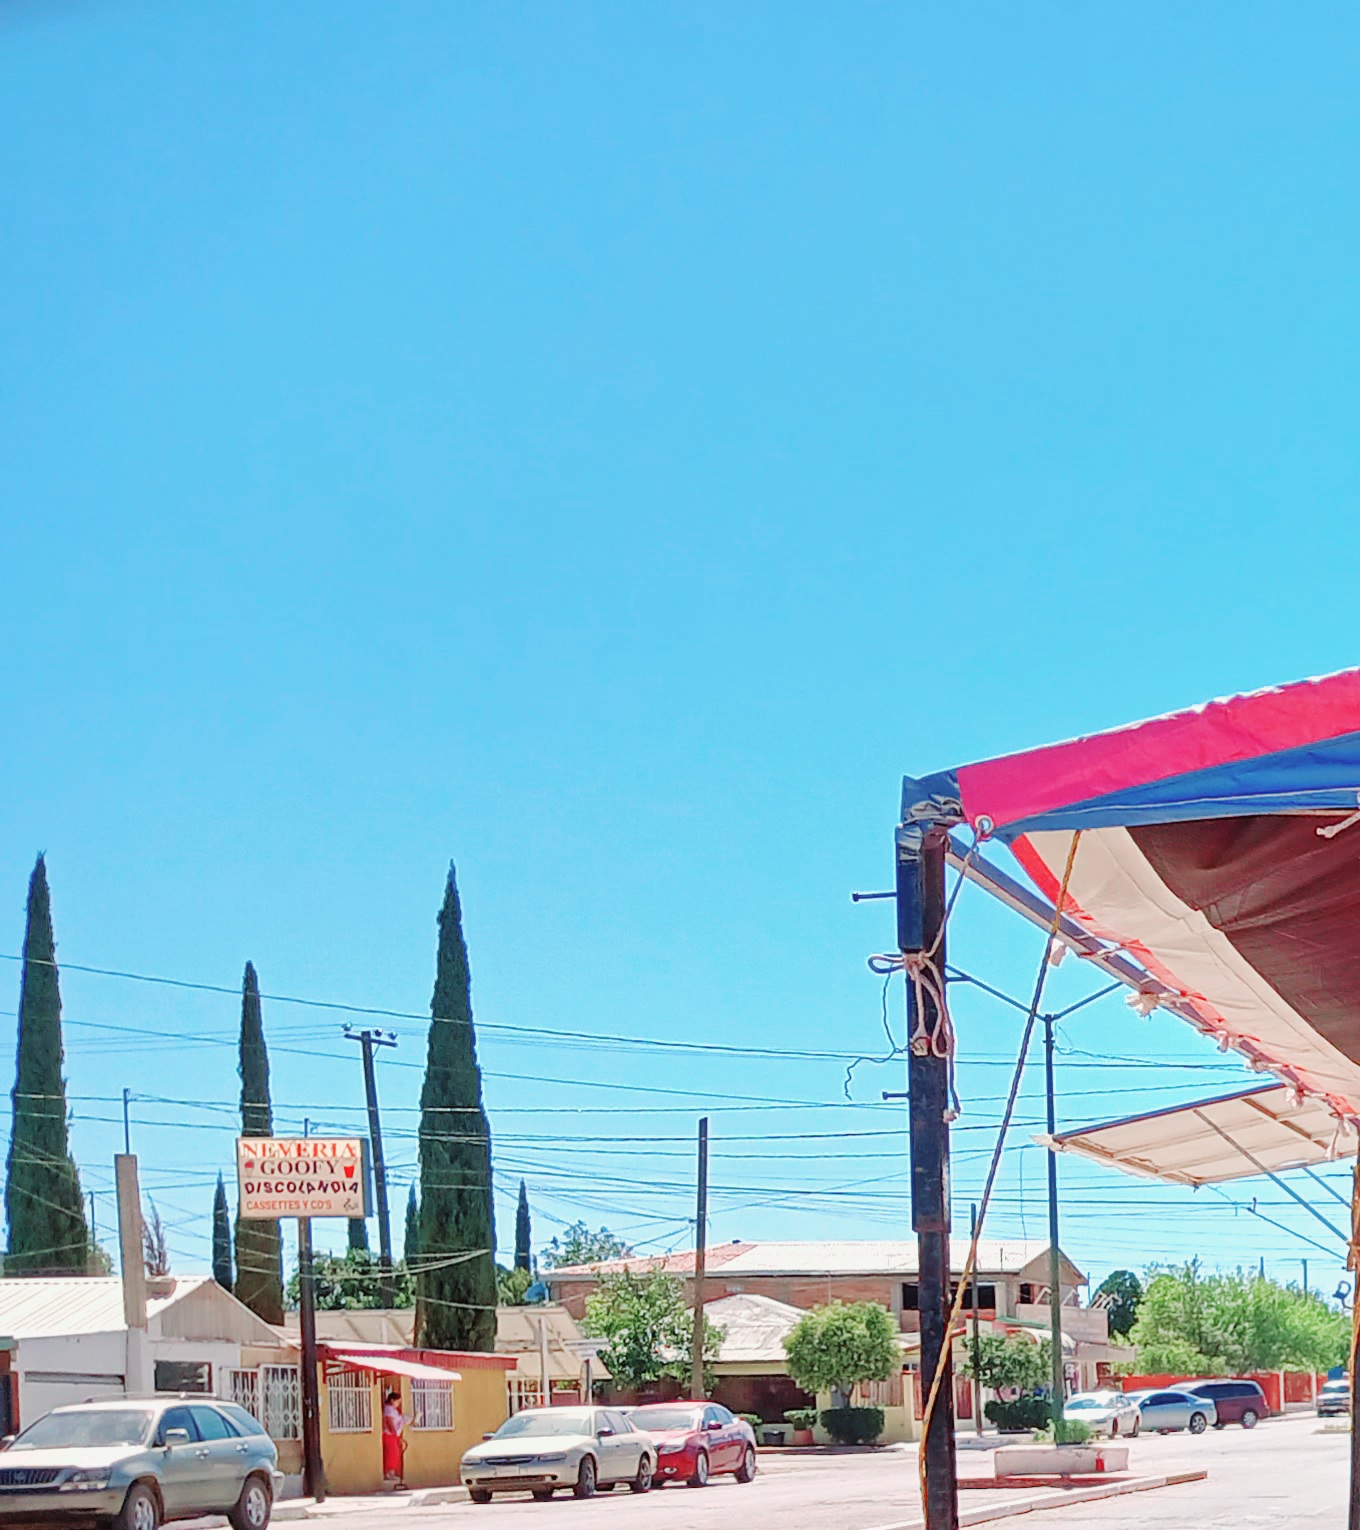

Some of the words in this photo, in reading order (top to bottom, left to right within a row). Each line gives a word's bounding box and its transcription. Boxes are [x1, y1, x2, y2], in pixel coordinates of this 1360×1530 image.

[260, 1160, 338, 1175] GOOFY
[244, 1180, 358, 1194] DISCOLANDIA
[246, 1200, 300, 1210] CASSETTES
